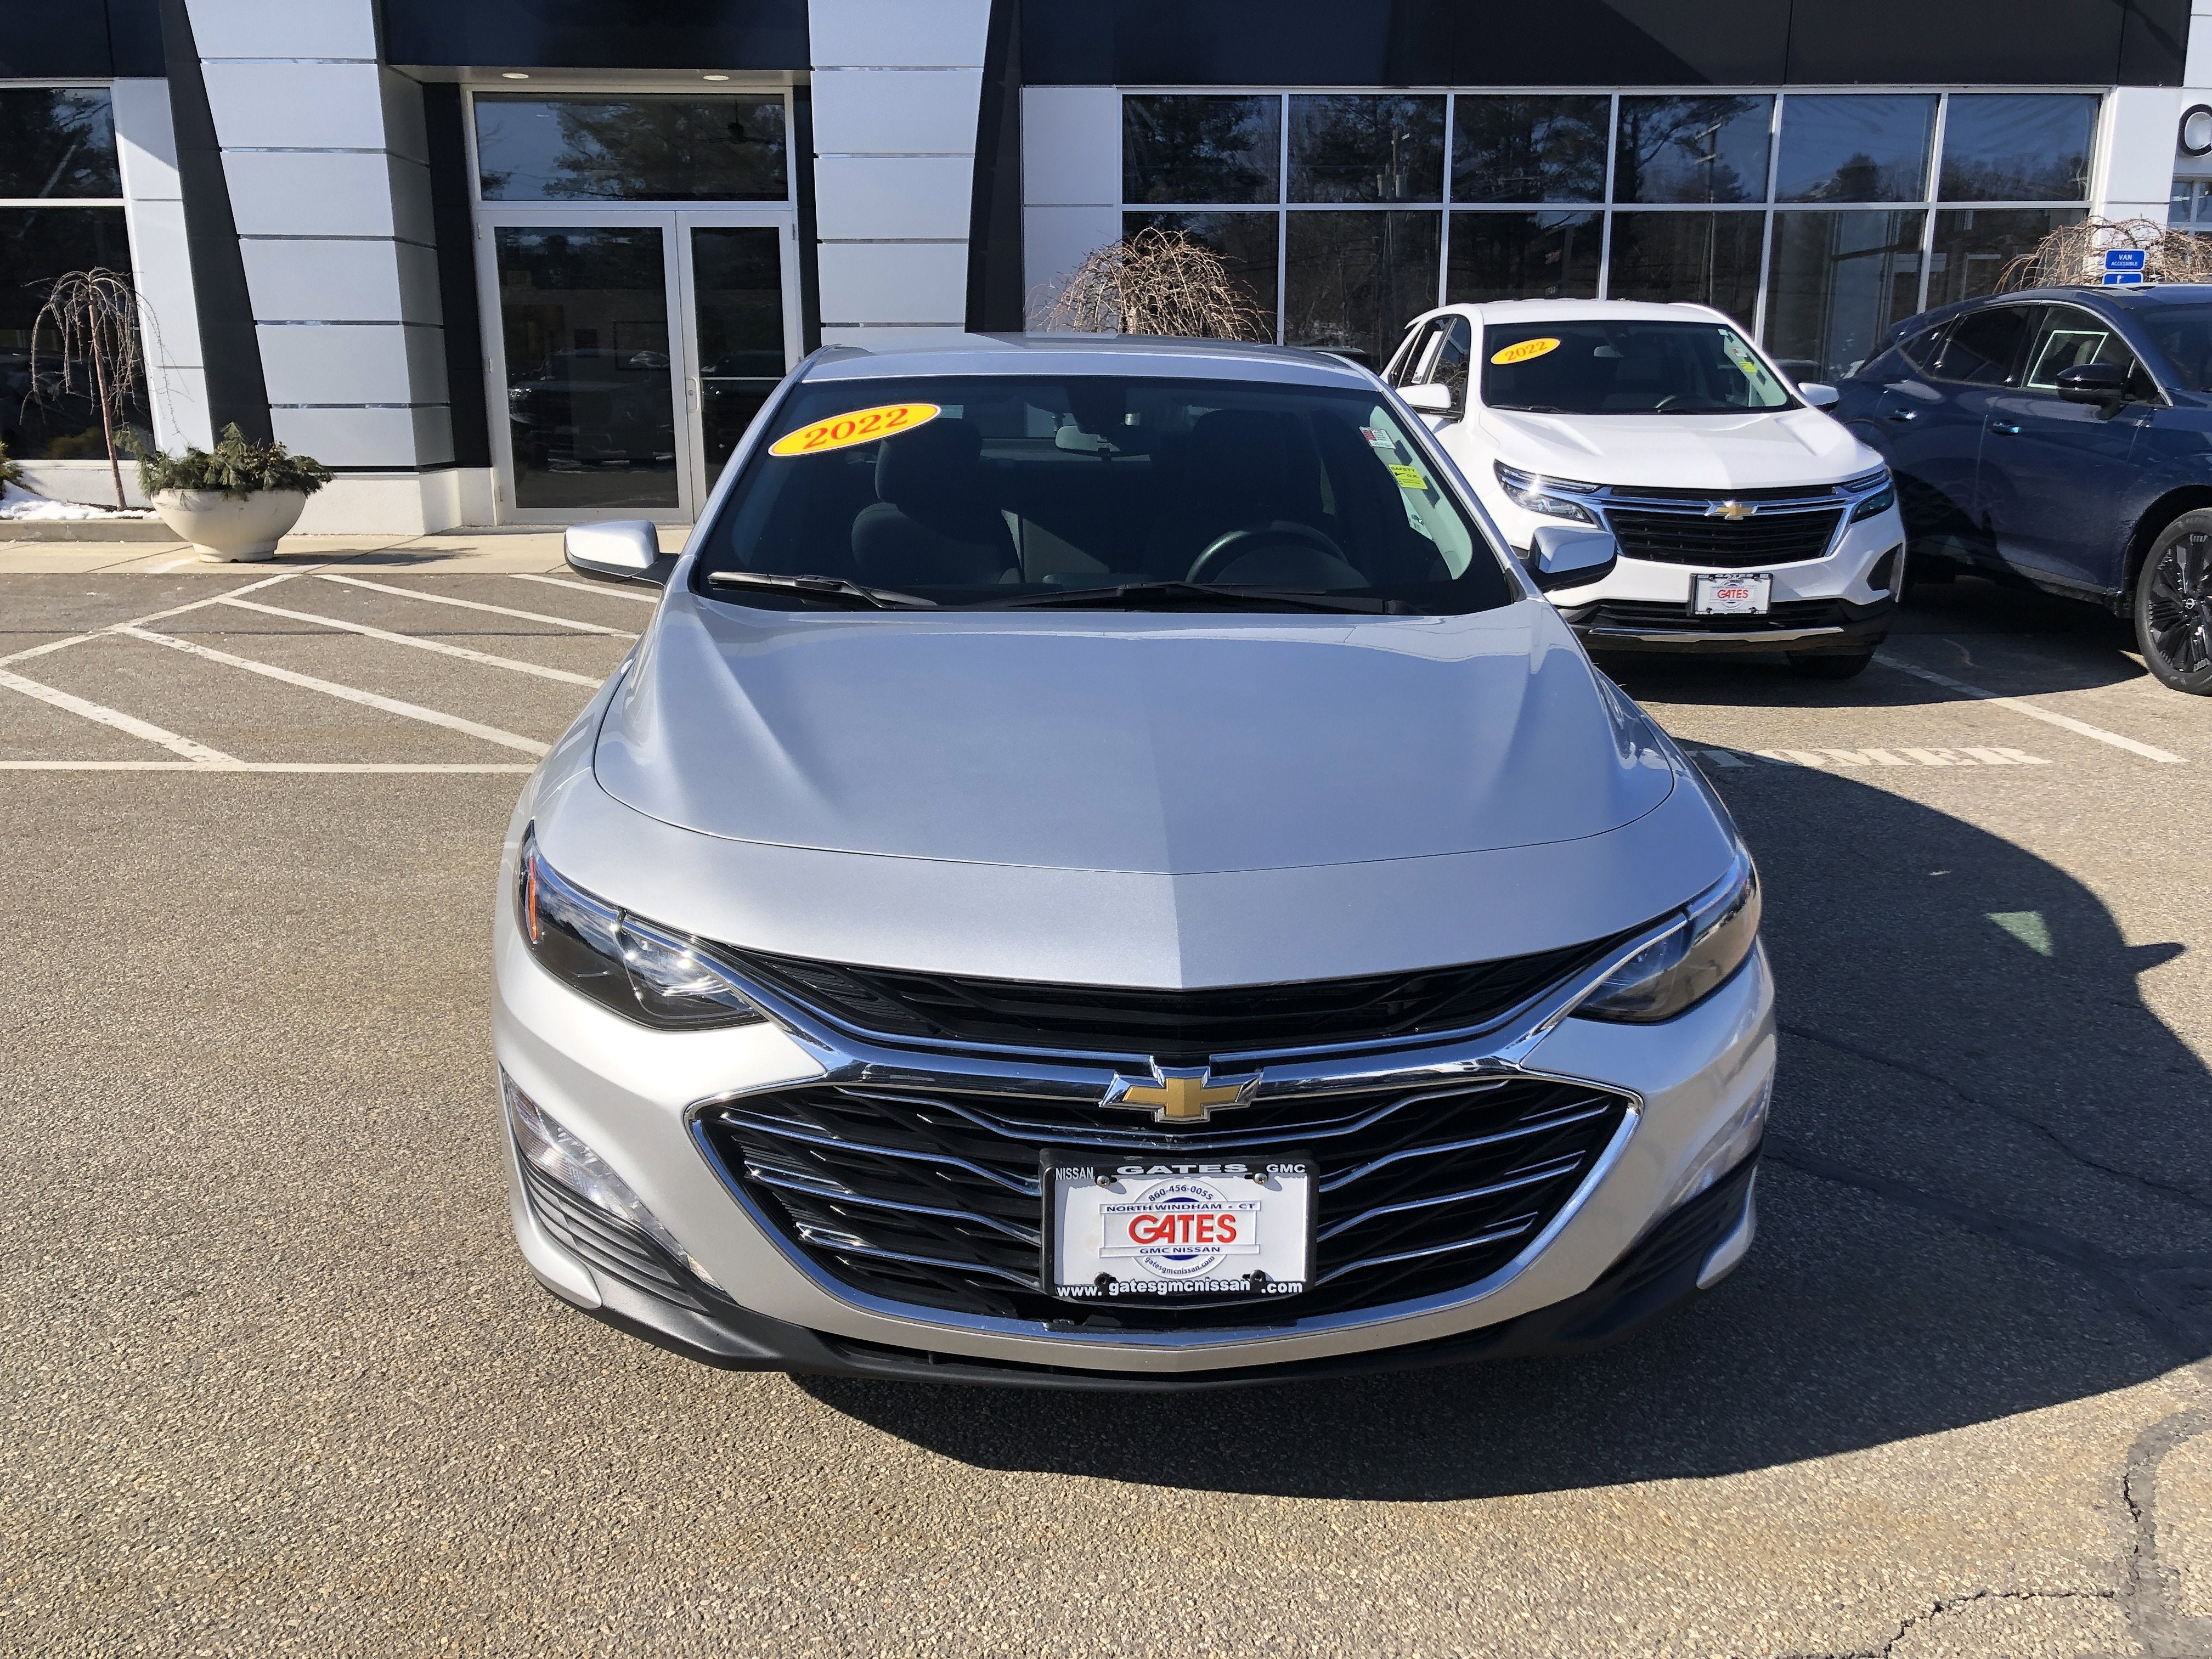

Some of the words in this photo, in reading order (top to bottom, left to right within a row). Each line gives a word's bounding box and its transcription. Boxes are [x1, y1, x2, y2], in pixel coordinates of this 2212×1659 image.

[1504, 341, 1548, 362] 2022
[802, 408, 908, 450] 2022
[1717, 589, 1748, 599] GATES
[1055, 1166, 1094, 1181] NISSAN
[1116, 1164, 1248, 1175] GATES
[1266, 1164, 1306, 1173] GMC
[1148, 1184, 1214, 1202] 860-456-0055
[1106, 1204, 1153, 1212] NORTH
[1128, 1214, 1237, 1244] GATES
[1144, 1255, 1215, 1275] gatesgmcnissan.com
[1057, 1286, 1102, 1297] www.
[1109, 1276, 1251, 1296] gatesgmcnissan
[1261, 1282, 1302, 1294] .com
